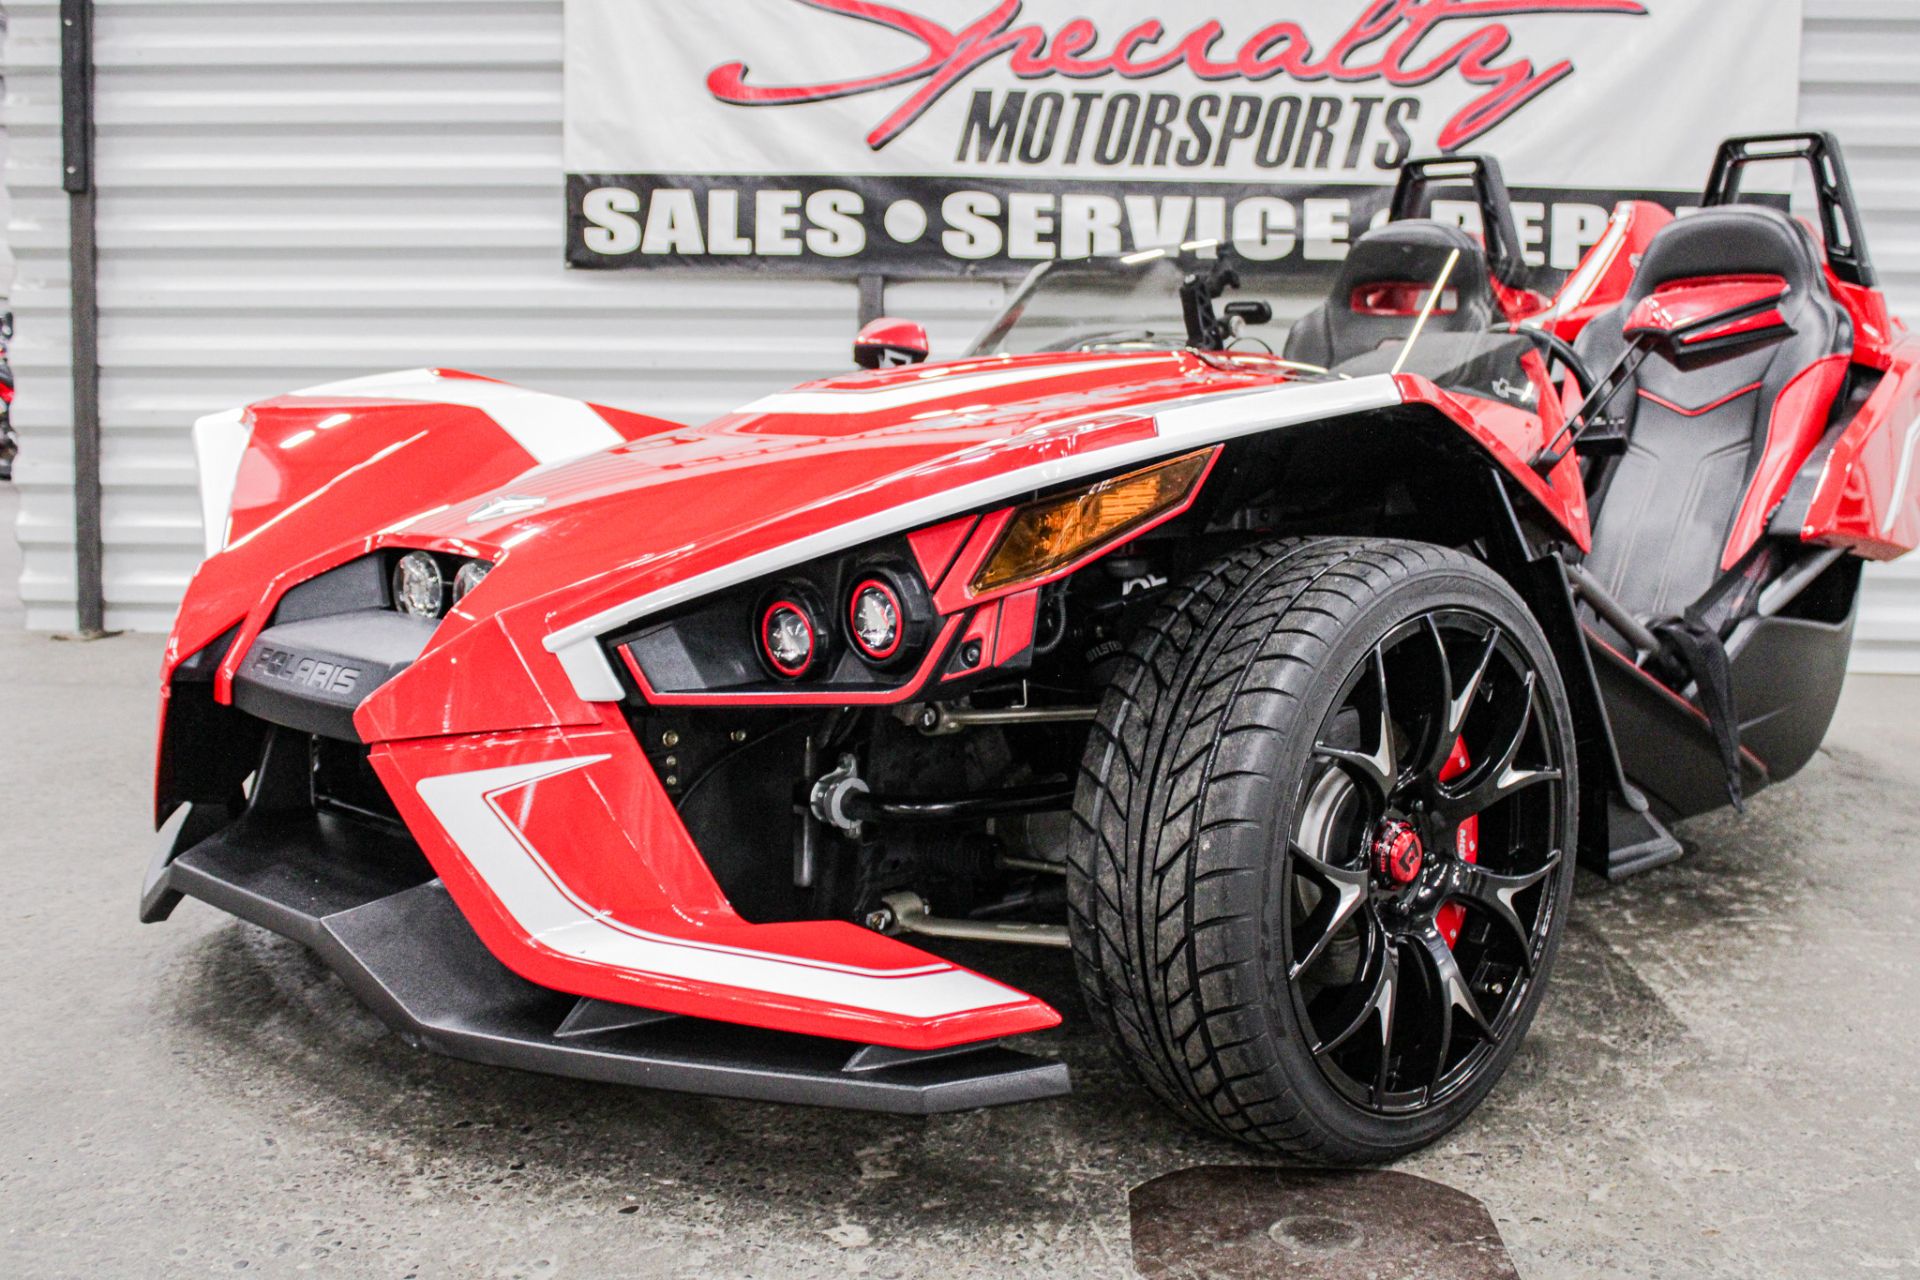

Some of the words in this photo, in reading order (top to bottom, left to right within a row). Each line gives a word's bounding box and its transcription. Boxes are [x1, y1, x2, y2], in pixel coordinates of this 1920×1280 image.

[704, 0, 1648, 151] Specialty
[955, 89, 1421, 170] MOTORSPORTS
[582, 187, 866, 257] SALES
[941, 190, 1351, 261] SERVICE
[251, 646, 361, 695] POLARIS
